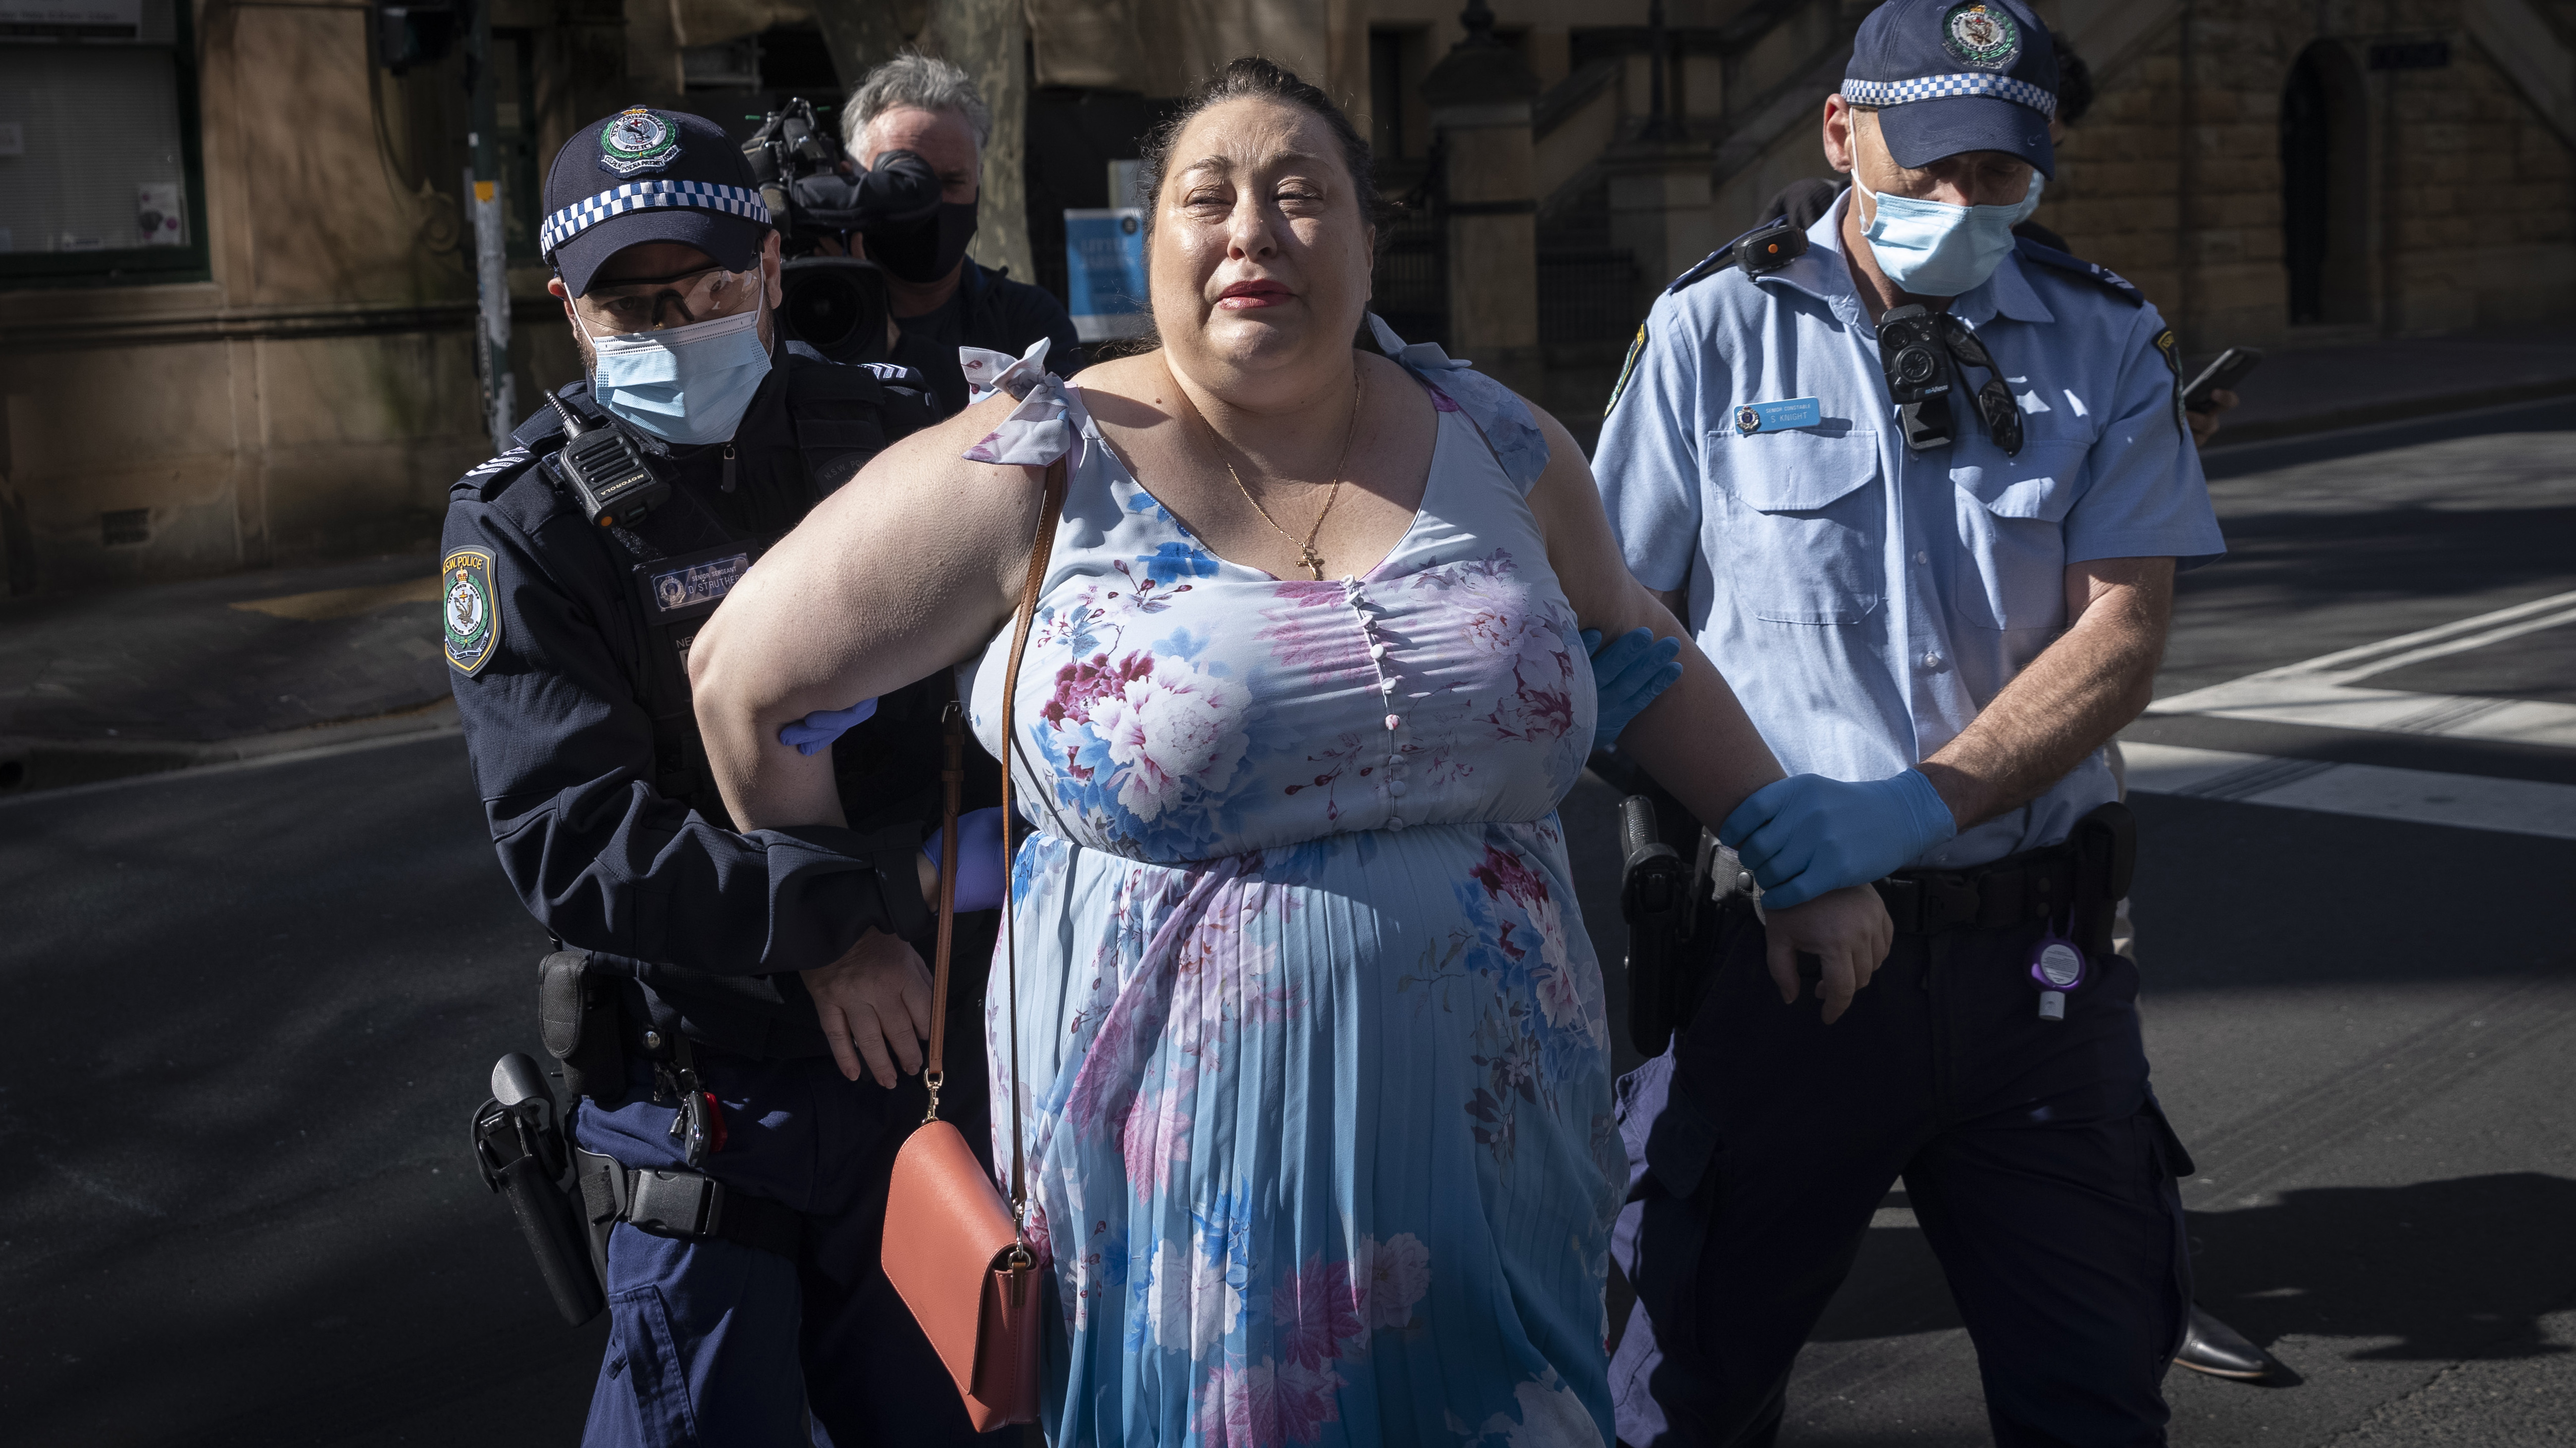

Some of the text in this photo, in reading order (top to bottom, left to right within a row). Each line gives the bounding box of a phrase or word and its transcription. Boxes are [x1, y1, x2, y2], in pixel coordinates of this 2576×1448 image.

[611, 114, 665, 137] NEW SOUTH WALES
[1780, 411, 1807, 422] KNIGHT
[600, 474, 644, 496] MOTOROLA
[458, 556, 483, 570] POLICE
[692, 566, 736, 582] SENIOR SERGEANT
[688, 586, 694, 594] D
[468, 620, 479, 633] FORCE
